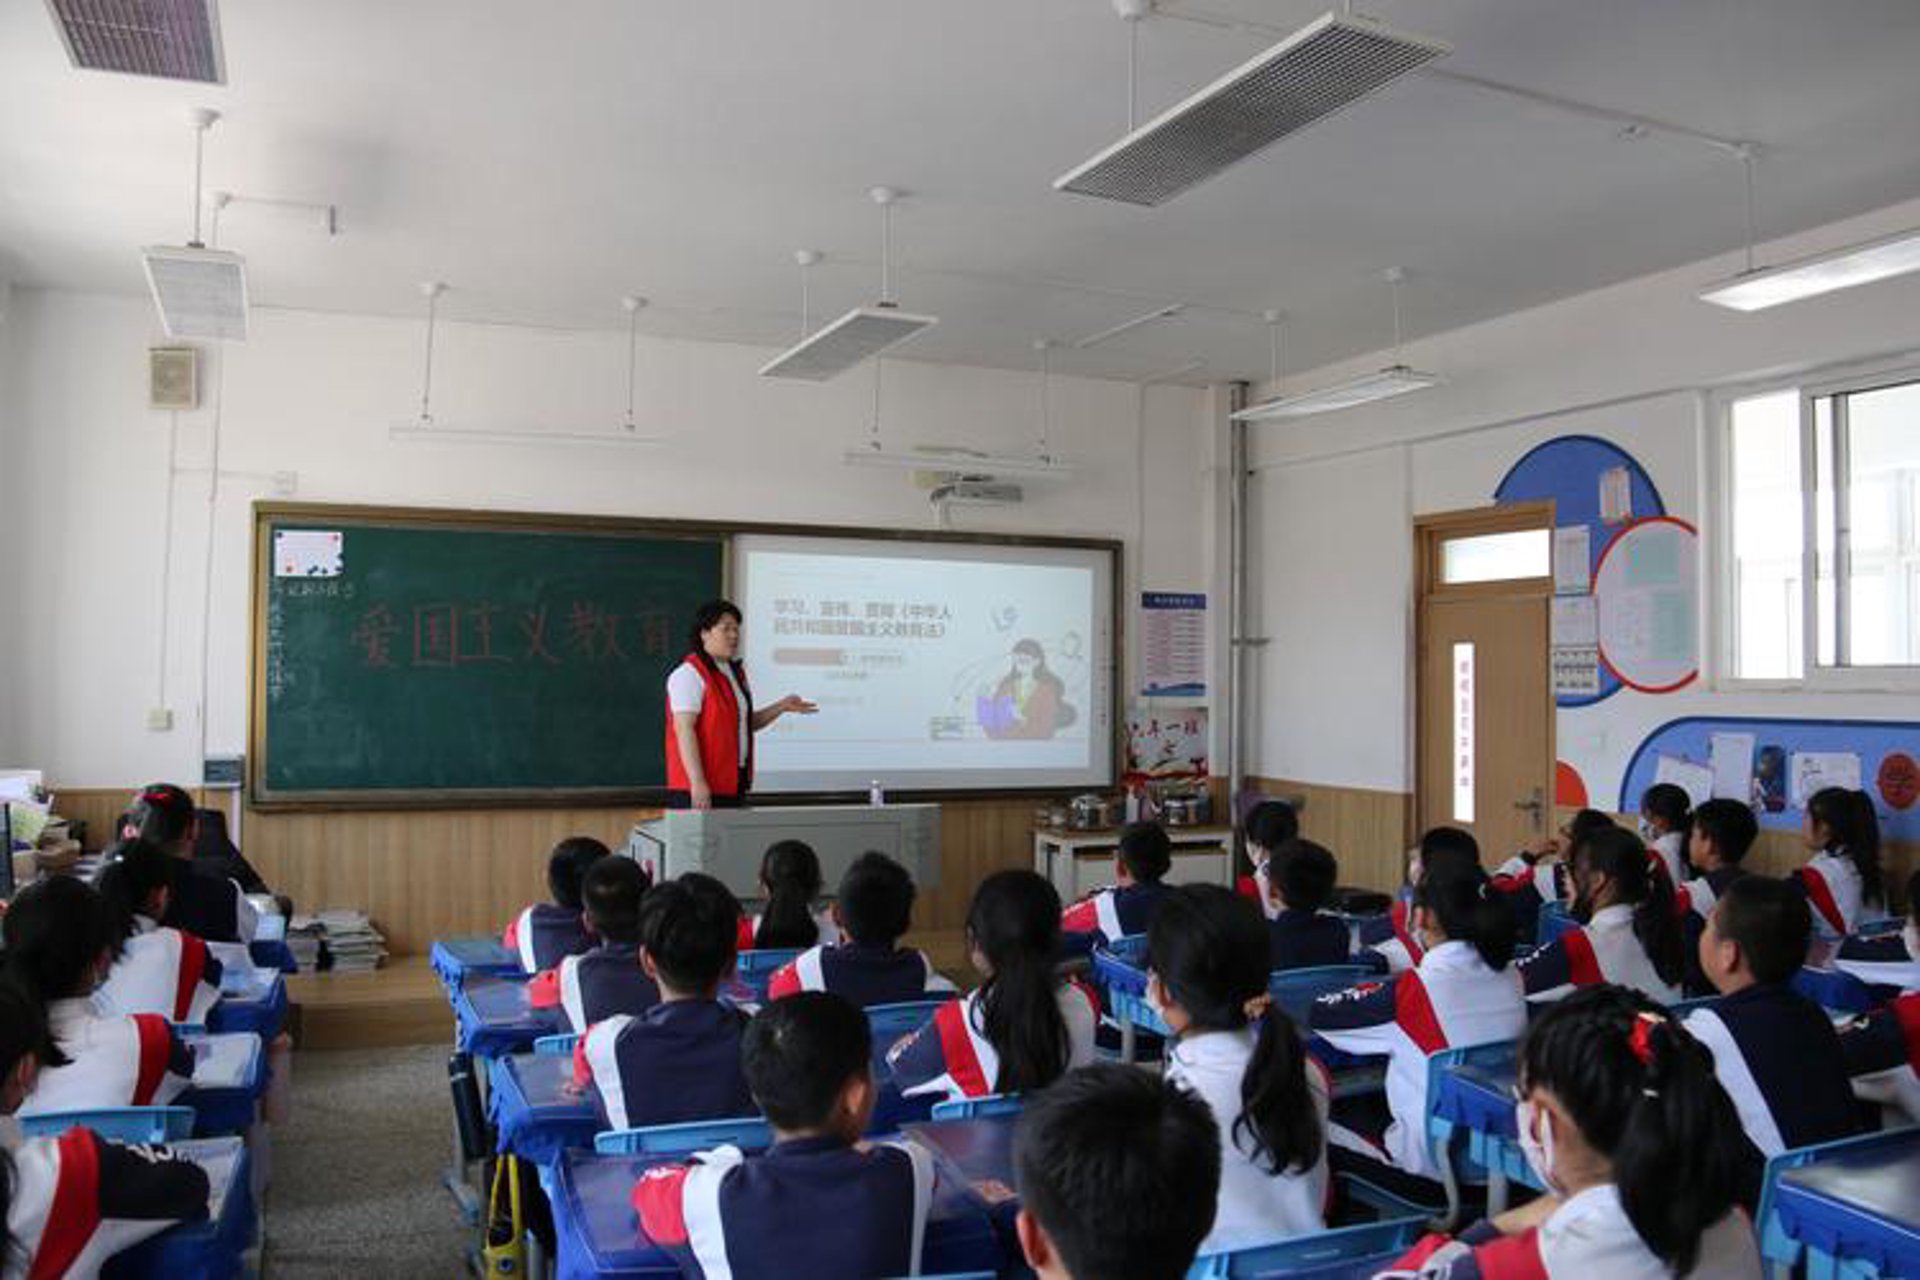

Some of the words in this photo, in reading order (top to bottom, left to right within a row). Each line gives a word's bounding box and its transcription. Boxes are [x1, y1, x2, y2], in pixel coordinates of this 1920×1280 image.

[350, 600, 674, 668] 爱国主义教育
